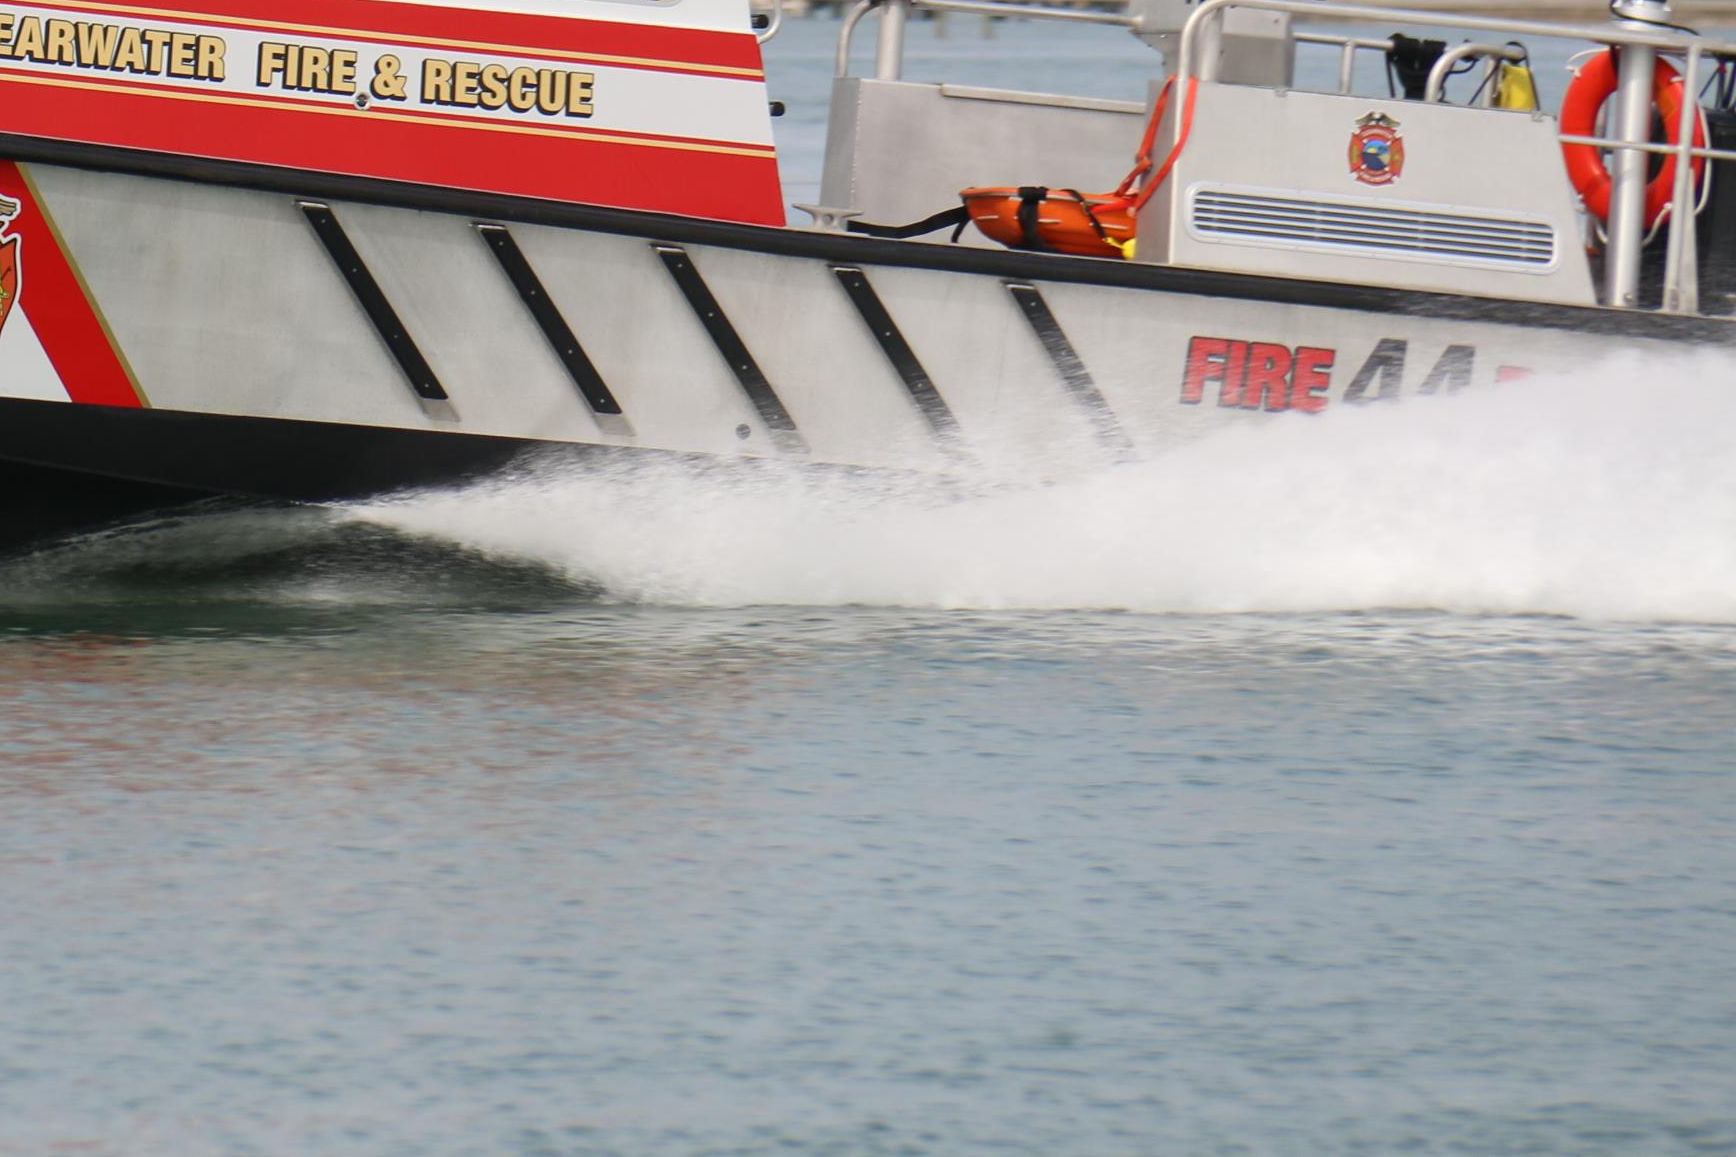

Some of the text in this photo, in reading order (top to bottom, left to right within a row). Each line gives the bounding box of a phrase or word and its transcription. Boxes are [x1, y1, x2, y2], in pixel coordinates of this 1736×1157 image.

[257, 41, 358, 95] FIRE
[369, 54, 407, 100] &
[420, 58, 594, 118] RESCUE
[1180, 336, 1336, 414] FIRE
